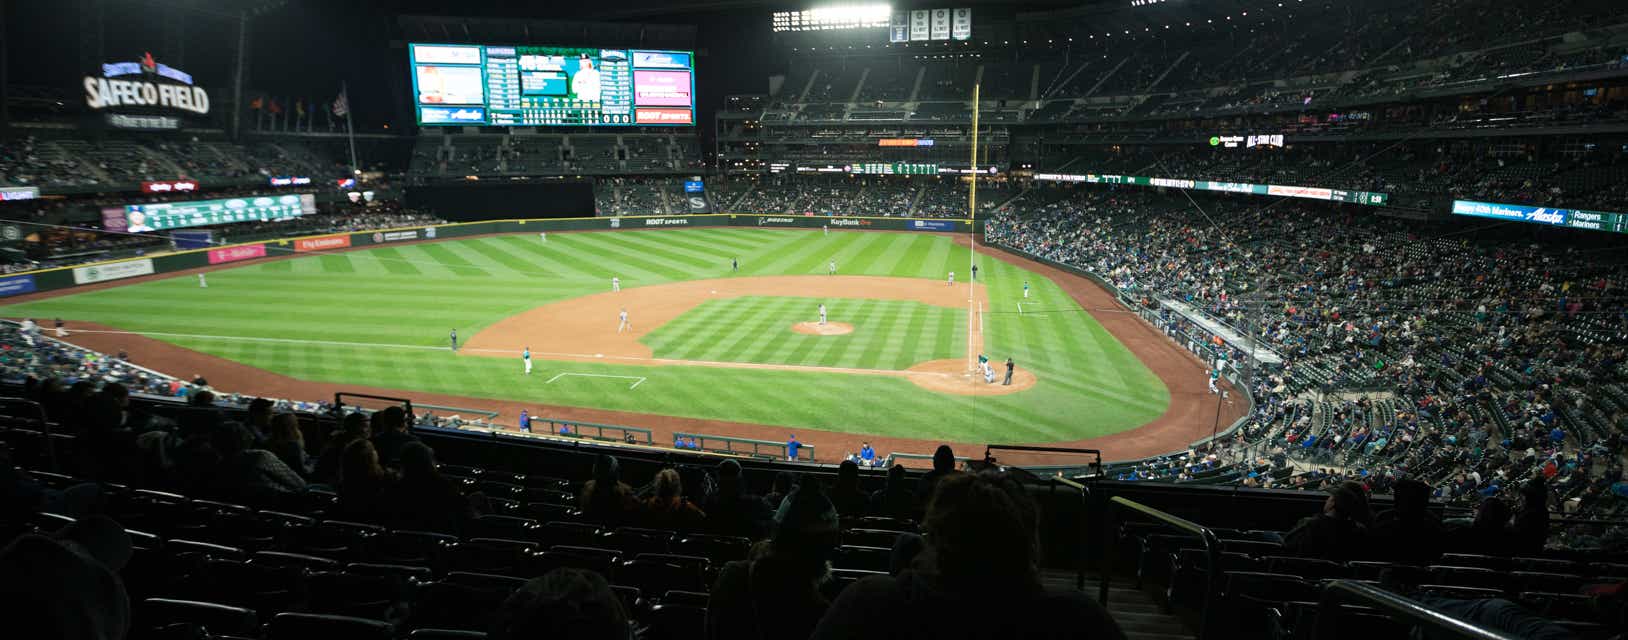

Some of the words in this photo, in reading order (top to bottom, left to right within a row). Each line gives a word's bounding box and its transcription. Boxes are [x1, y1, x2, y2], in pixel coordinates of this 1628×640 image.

[84, 76, 158, 108] SAFECO
[158, 83, 210, 114] FIELD
[1574, 210, 1601, 221] Rangers
[830, 218, 859, 226] KeyBank
[1572, 220, 1600, 229] Mariners
